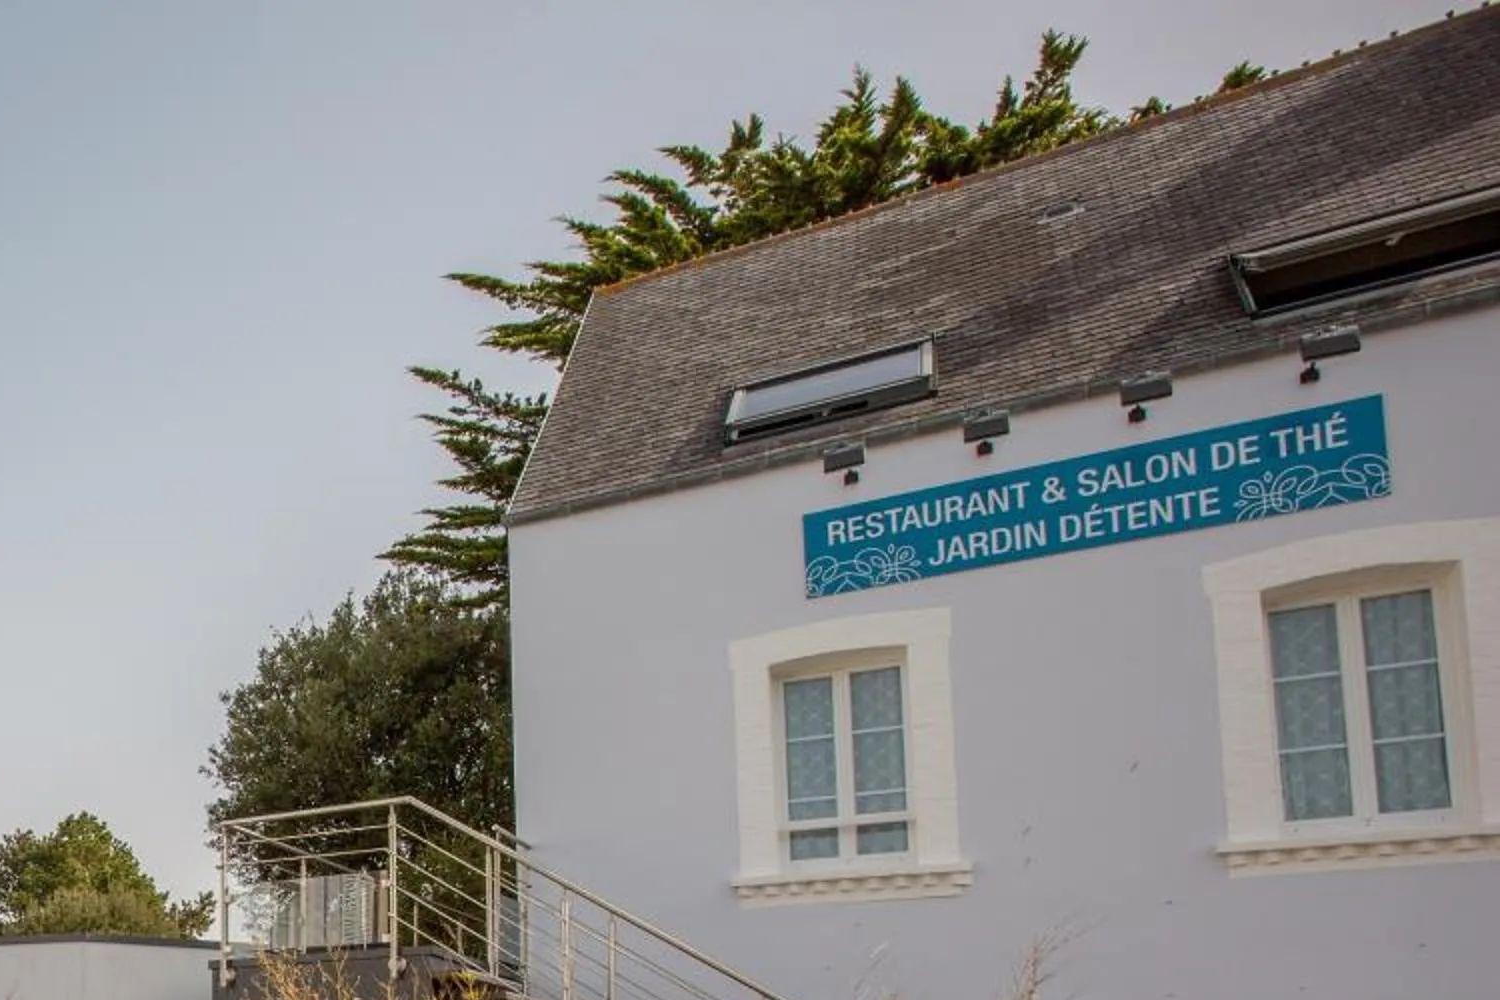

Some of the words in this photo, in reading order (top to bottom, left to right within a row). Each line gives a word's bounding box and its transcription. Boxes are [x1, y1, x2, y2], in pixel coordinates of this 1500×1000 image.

[826, 481, 1032, 546] RESTAURANT
[1040, 476, 1067, 505] &
[1077, 447, 1198, 498] SALON
[1210, 434, 1260, 472] DE
[1269, 412, 1349, 460] THÉ
[928, 520, 1049, 567] JARDIN
[1059, 487, 1221, 543] DÉTENTE
